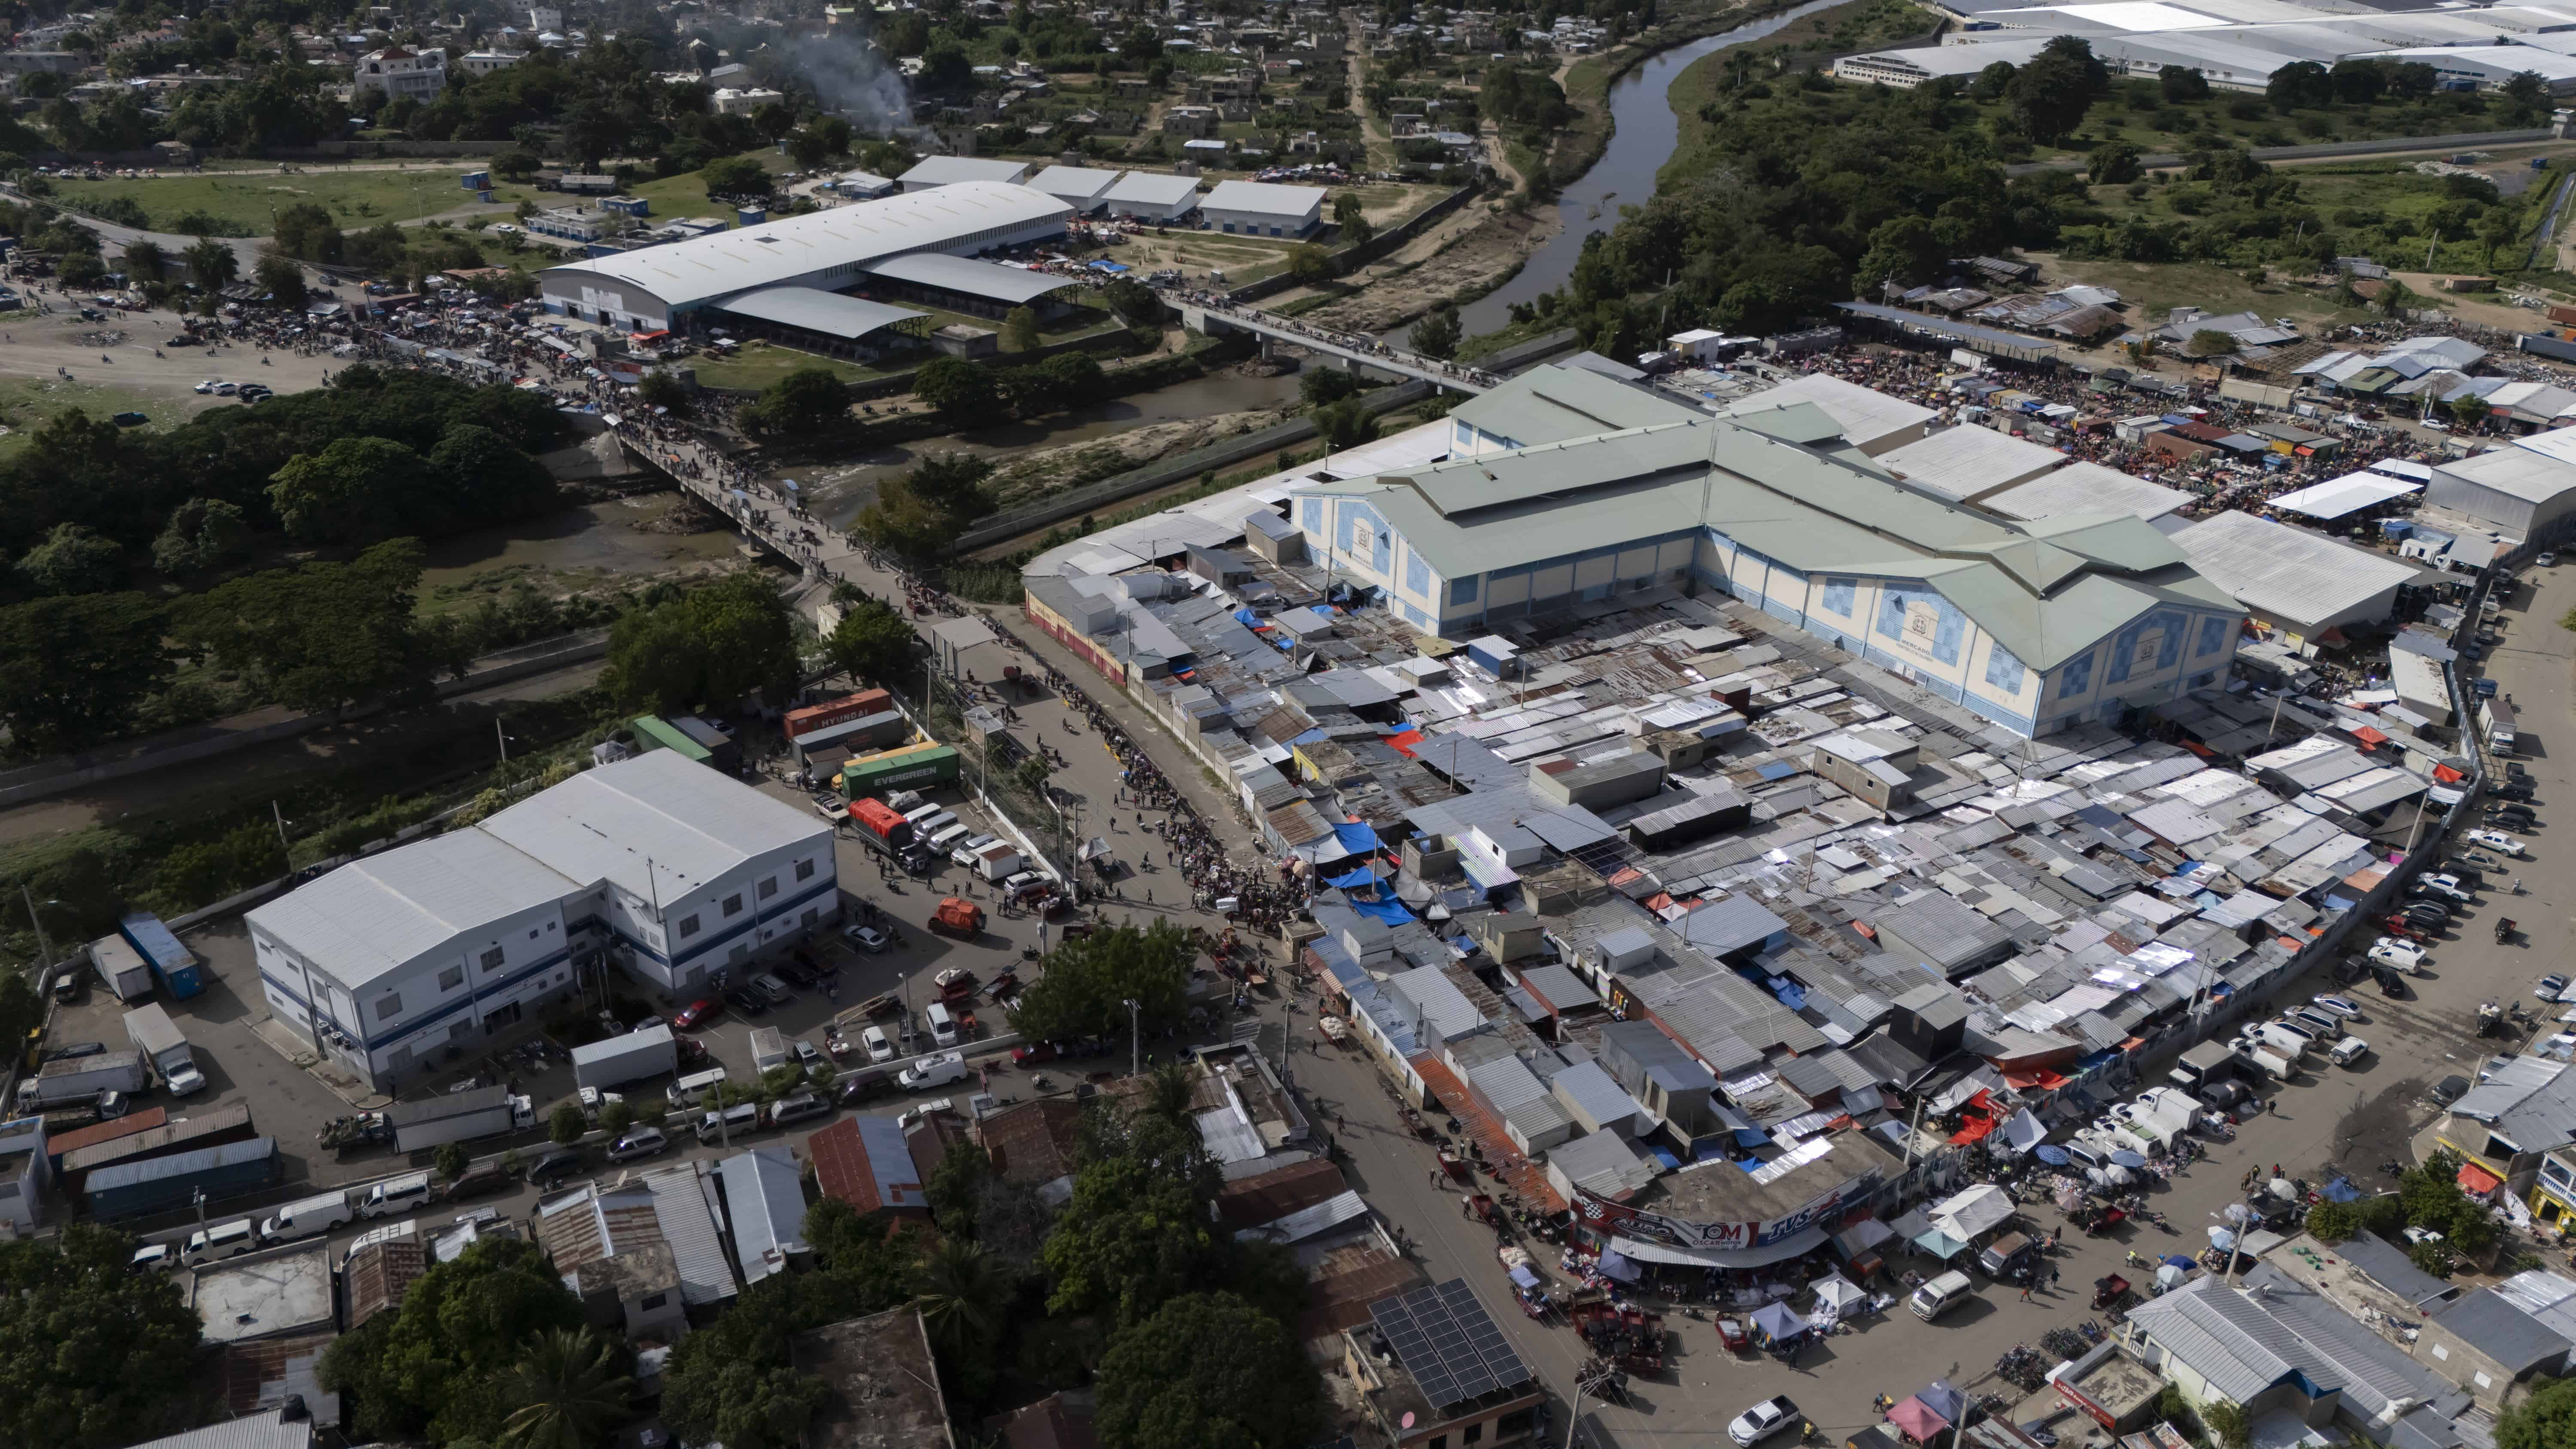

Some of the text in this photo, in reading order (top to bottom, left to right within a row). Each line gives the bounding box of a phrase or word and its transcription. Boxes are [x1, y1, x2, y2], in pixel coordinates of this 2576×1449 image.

[1901, 638, 1930, 656] MERCADO
[821, 709, 869, 727] HYUNDAI
[874, 766, 937, 787] EVERGREEN
[1613, 1218, 1672, 1237] AURO
[1768, 1208, 1811, 1240] TVS
